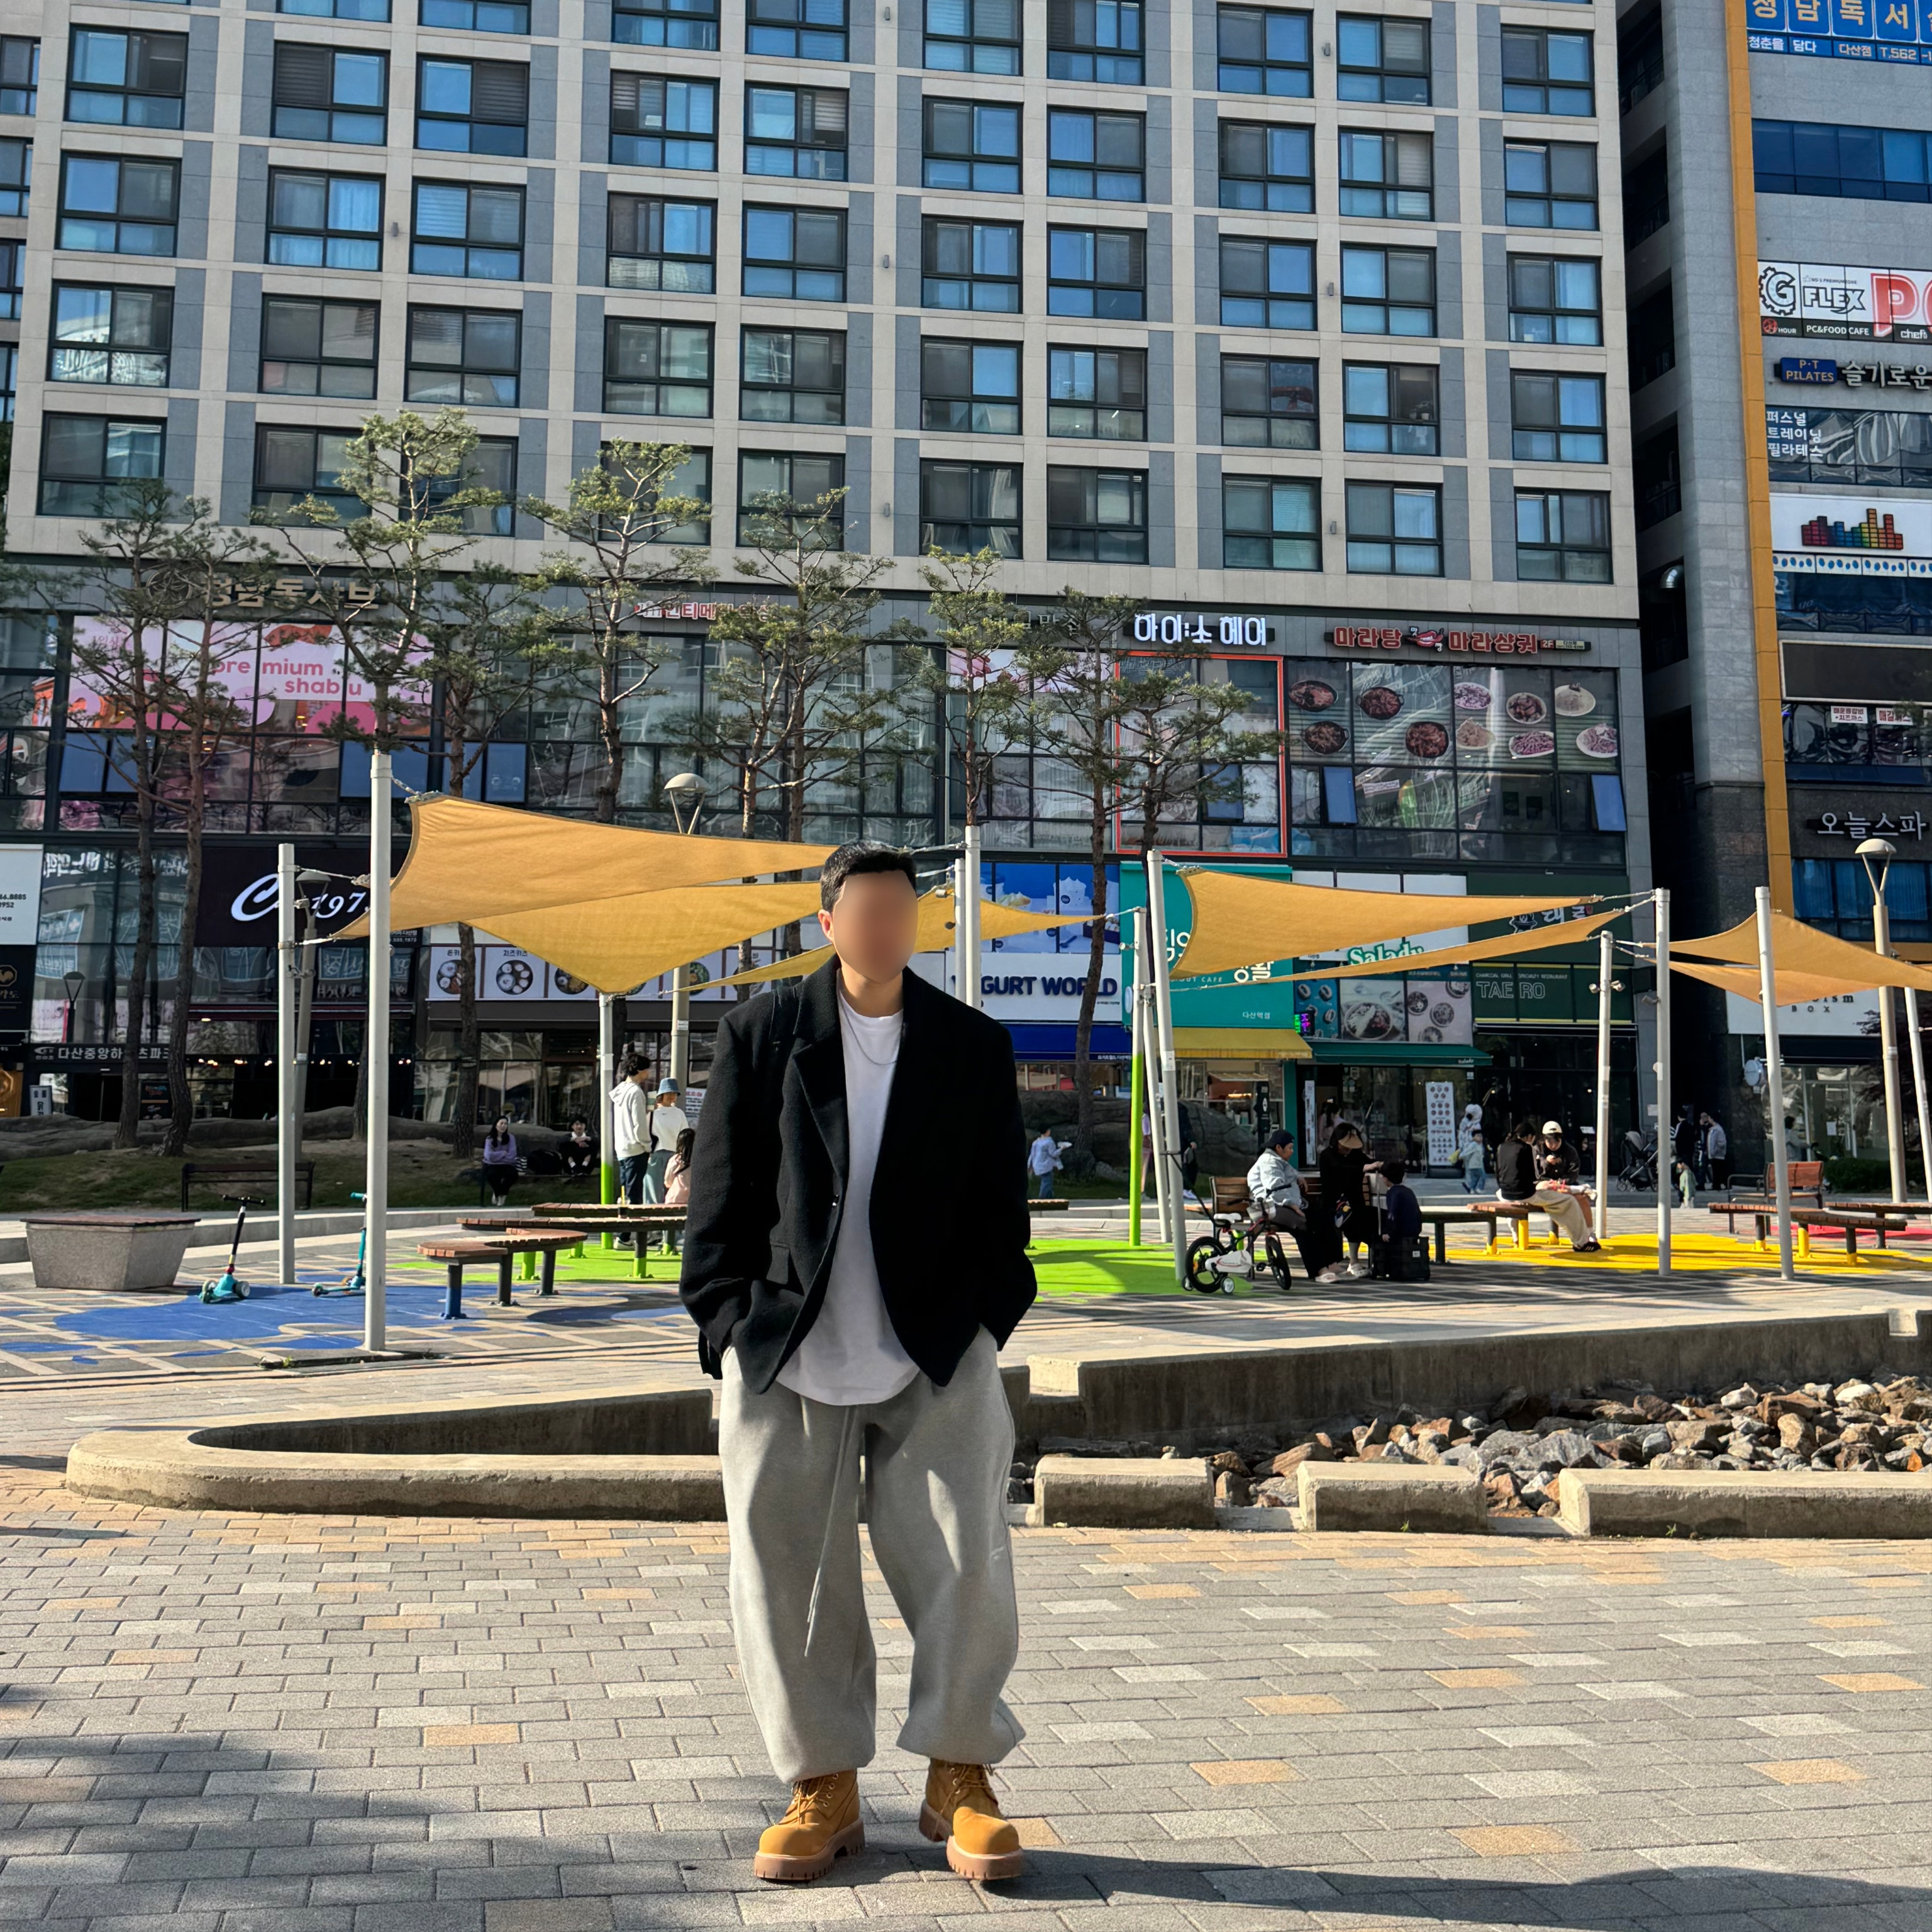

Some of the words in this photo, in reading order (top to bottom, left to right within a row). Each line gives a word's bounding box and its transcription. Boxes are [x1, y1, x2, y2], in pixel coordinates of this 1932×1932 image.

[1748, 36, 1784, 51] 청춘을
[1793, 40, 1816, 53] 담다
[1839, 43, 1872, 57] 다산점
[1803, 286, 1866, 314] FLEX
[1870, 273, 1932, 338] P
[1806, 325, 1846, 335] PC&FOOD
[1848, 327, 1869, 336] CAFE
[1785, 370, 1834, 382] PILATES
[1841, 360, 1932, 390] 슬기로운
[1767, 411, 1807, 426] 퍼스널
[1767, 428, 1822, 443] 트레이닝
[1767, 442, 1824, 458] 필라테스
[1219, 616, 1267, 646] 헤어
[1334, 626, 1403, 649] 마라탕
[1448, 630, 1538, 654] 마라샹궈
[1542, 640, 1554, 648] 2F
[284, 677, 362, 696] shabu
[1817, 811, 1927, 841] 오늘스파
[1475, 981, 1514, 999] TAE
[1519, 982, 1546, 999] RO
[1791, 1004, 1830, 1013] BOX
